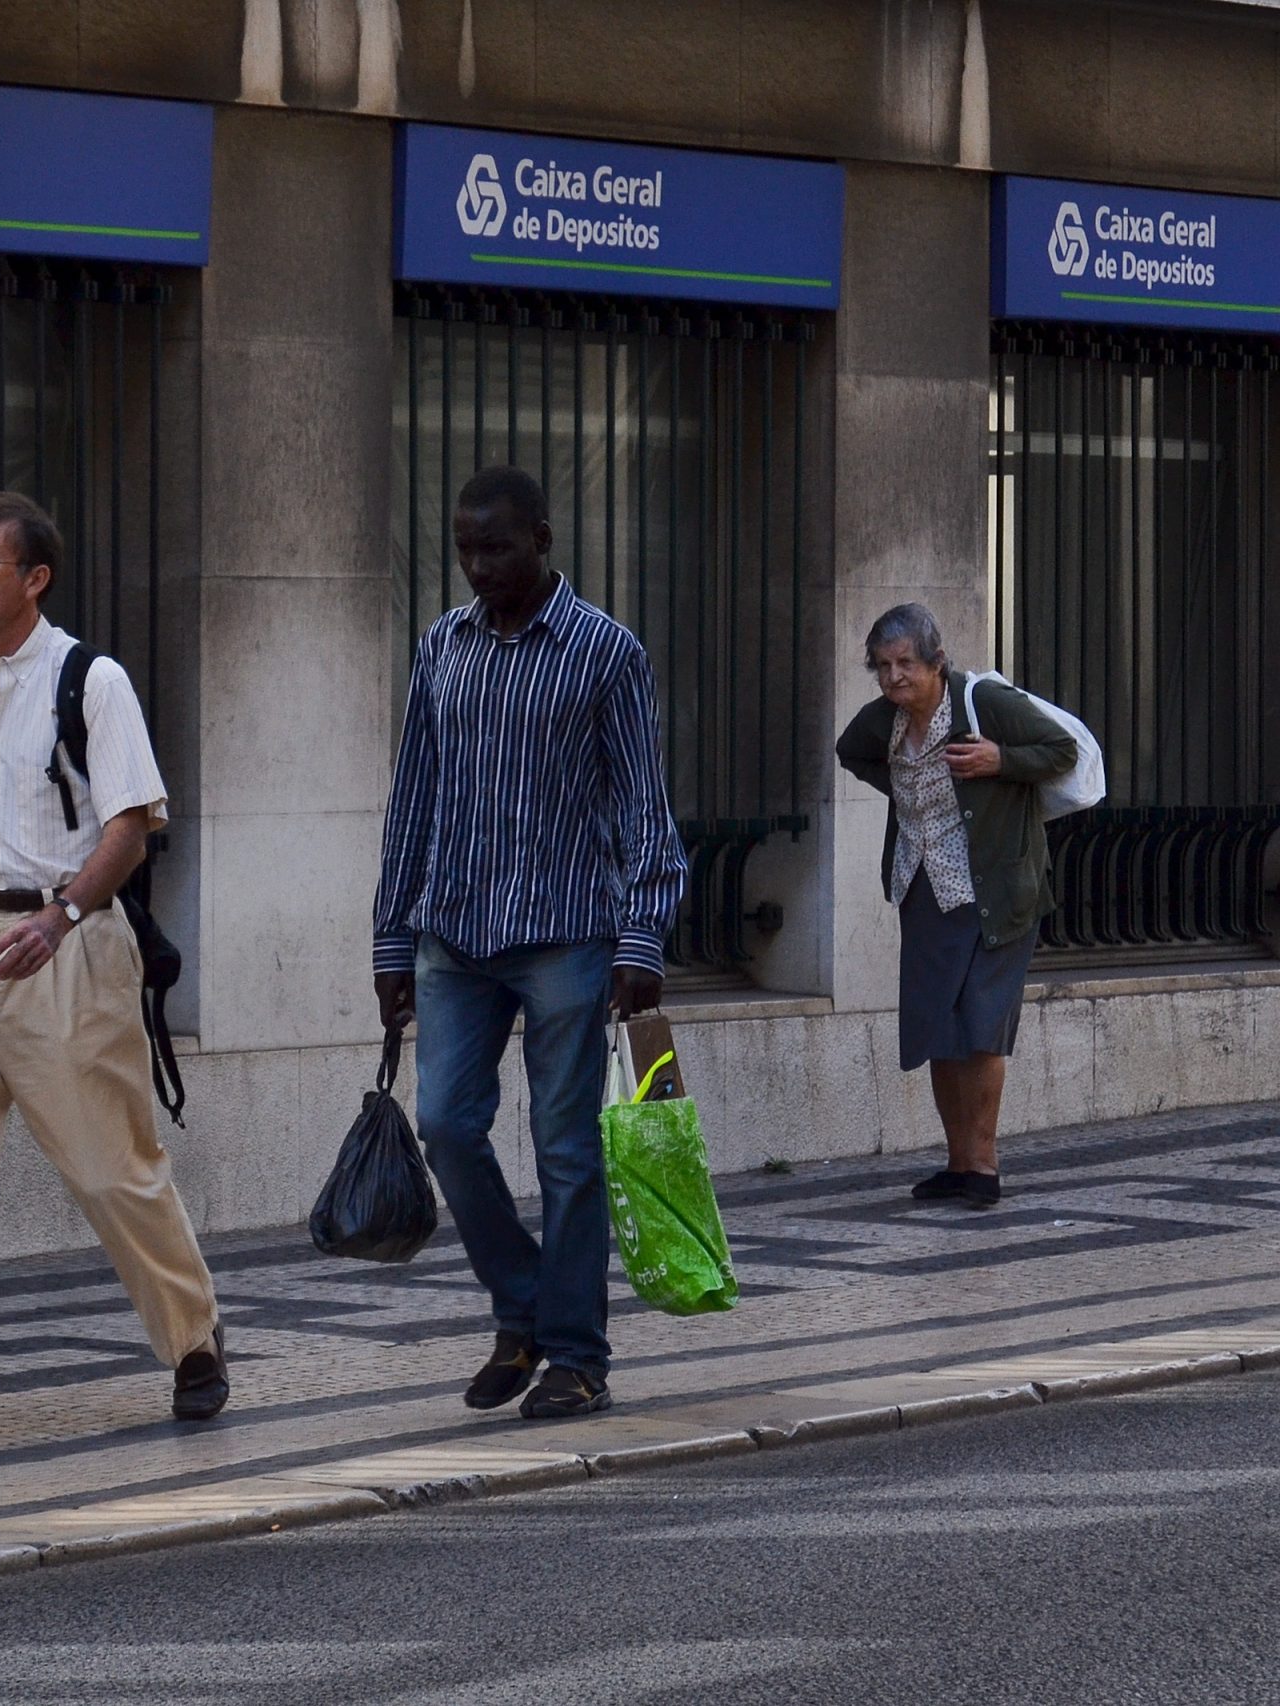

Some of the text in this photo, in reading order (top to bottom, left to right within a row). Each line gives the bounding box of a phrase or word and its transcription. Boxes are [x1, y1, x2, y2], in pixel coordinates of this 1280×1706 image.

[515, 159, 662, 207] Caixa Geral
[513, 208, 541, 240] de
[1095, 205, 1216, 248] Caixa Geral
[1094, 250, 1118, 280] de
